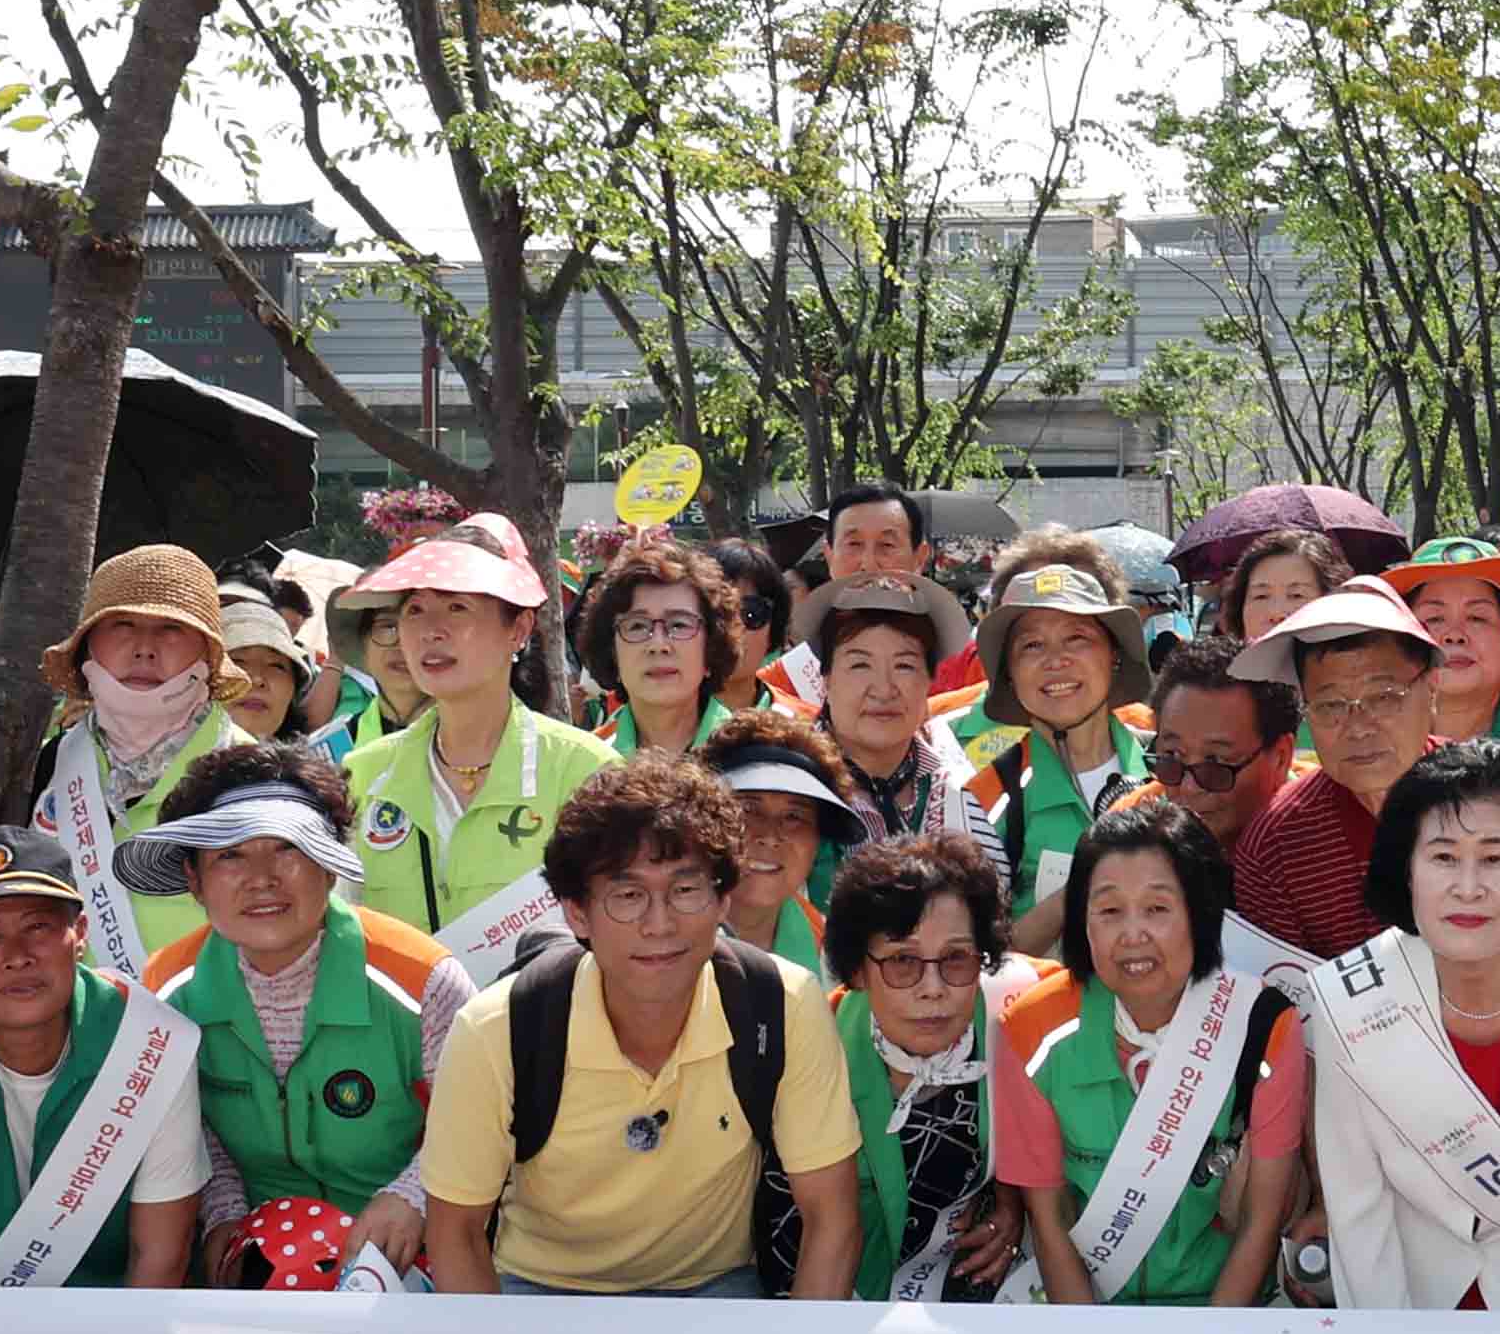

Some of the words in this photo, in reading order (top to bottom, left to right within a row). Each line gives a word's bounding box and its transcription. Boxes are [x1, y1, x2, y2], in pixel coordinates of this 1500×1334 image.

[67, 775, 101, 877] 안전제일
[110, 1025, 171, 1119] 실천해요
[1141, 1065, 1203, 1178] 안전문화!
[49, 1122, 124, 1230] 안전문화!
[1087, 1186, 1147, 1264] 만들어요
